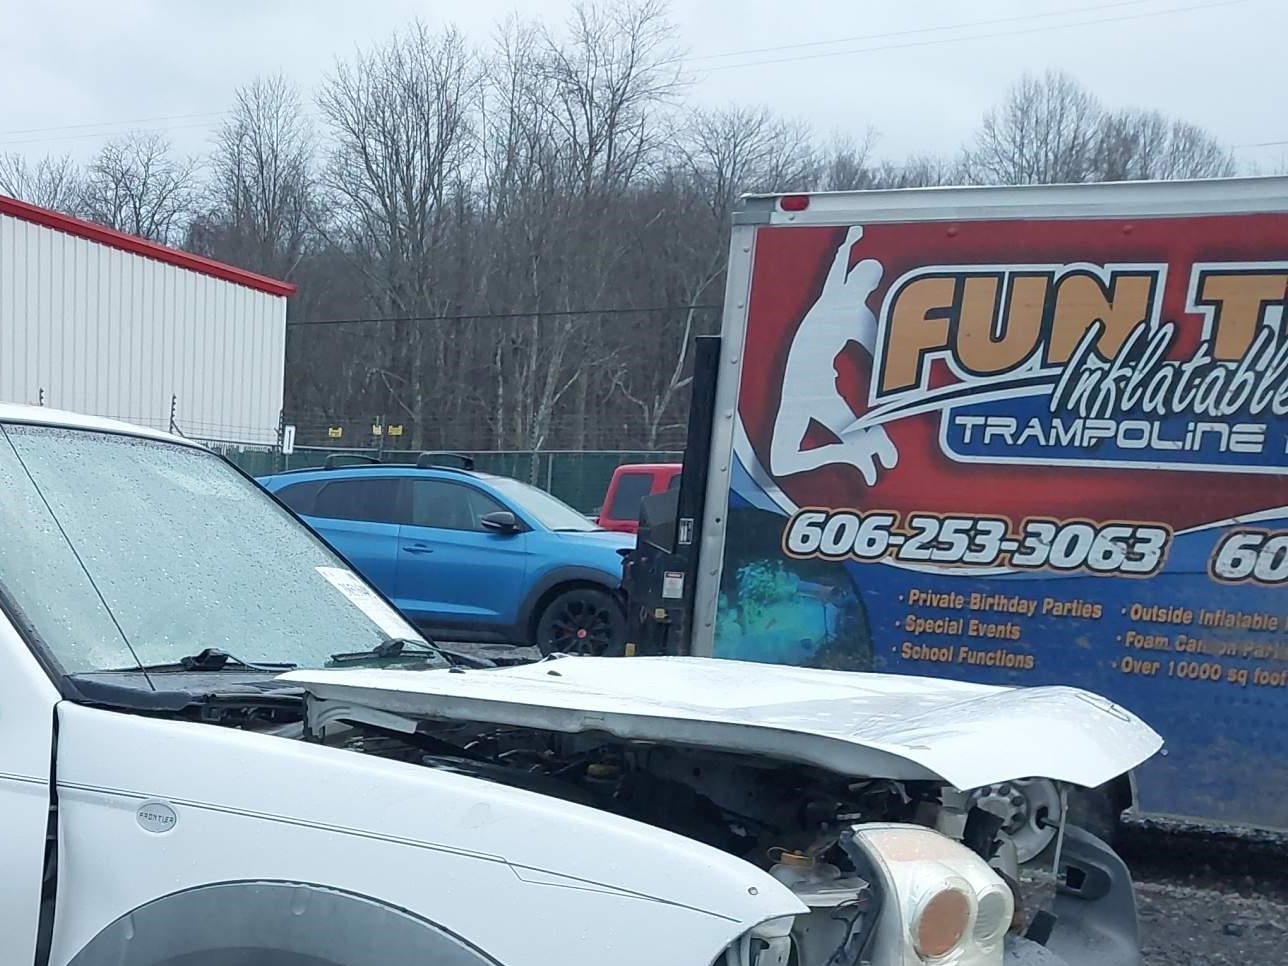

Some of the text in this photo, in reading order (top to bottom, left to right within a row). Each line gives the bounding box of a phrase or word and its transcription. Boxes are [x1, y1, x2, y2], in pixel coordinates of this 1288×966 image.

[877, 270, 1160, 401] FUN
[786, 511, 1167, 573] 606-253-3063
[908, 589, 1103, 618] Private Birthday Parties
[1130, 603, 1279, 631] Outside Inflatable
[905, 614, 1021, 640] Special Events
[1125, 631, 1169, 649] Foam
[901, 642, 1034, 669] School Functions
[1121, 656, 1160, 675] Over
[1168, 660, 1223, 680] 10000
[1227, 669, 1248, 685] sq
[139, 811, 175, 824] FRONTIER
